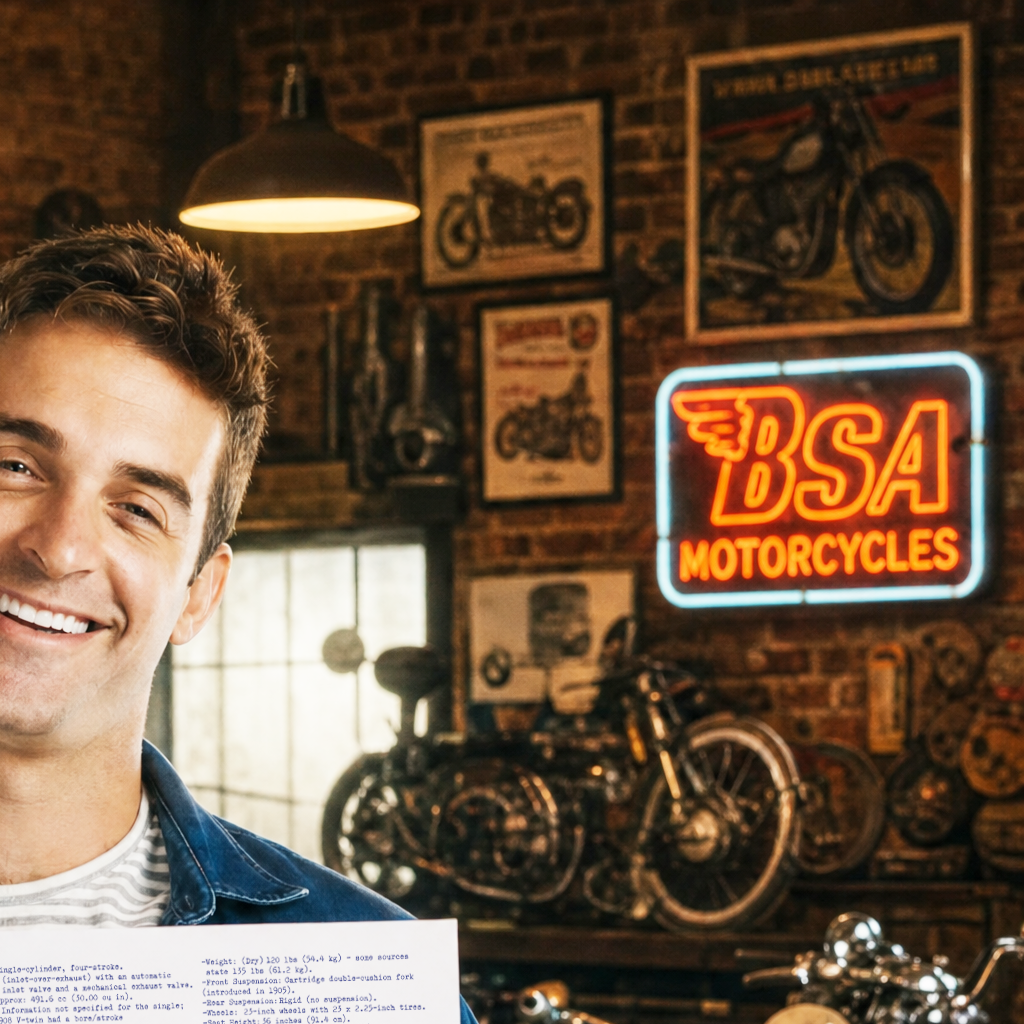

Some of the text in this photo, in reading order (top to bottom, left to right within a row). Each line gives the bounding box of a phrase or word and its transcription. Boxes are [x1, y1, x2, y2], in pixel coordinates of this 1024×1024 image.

[709, 386, 949, 526] BSA
[679, 526, 960, 582] MOTORCYCLES
[71, 963, 123, 972] four-stroke.
[202, 958, 236, 967] -Weight:
[295, 965, 312, 974] kg).
[2, 972, 171, 984] (inlet-over-exhaust) with automatic
[202, 973, 414, 986] -Front Suspension: Cartridge double-cushion fork
[3, 986, 24, 994] inlet
[82, 983, 126, 992] mechanical
[202, 988, 251, 997] (introduced
[324, 993, 377, 1004] suspension).
[73, 1003, 113, 1013] specified
[153, 1002, 184, 1011] single;
[310, 1006, 329, 1014] with
[16, 1016, 44, 1024] V-twin
[74, 1014, 123, 1022] bore/stroke
